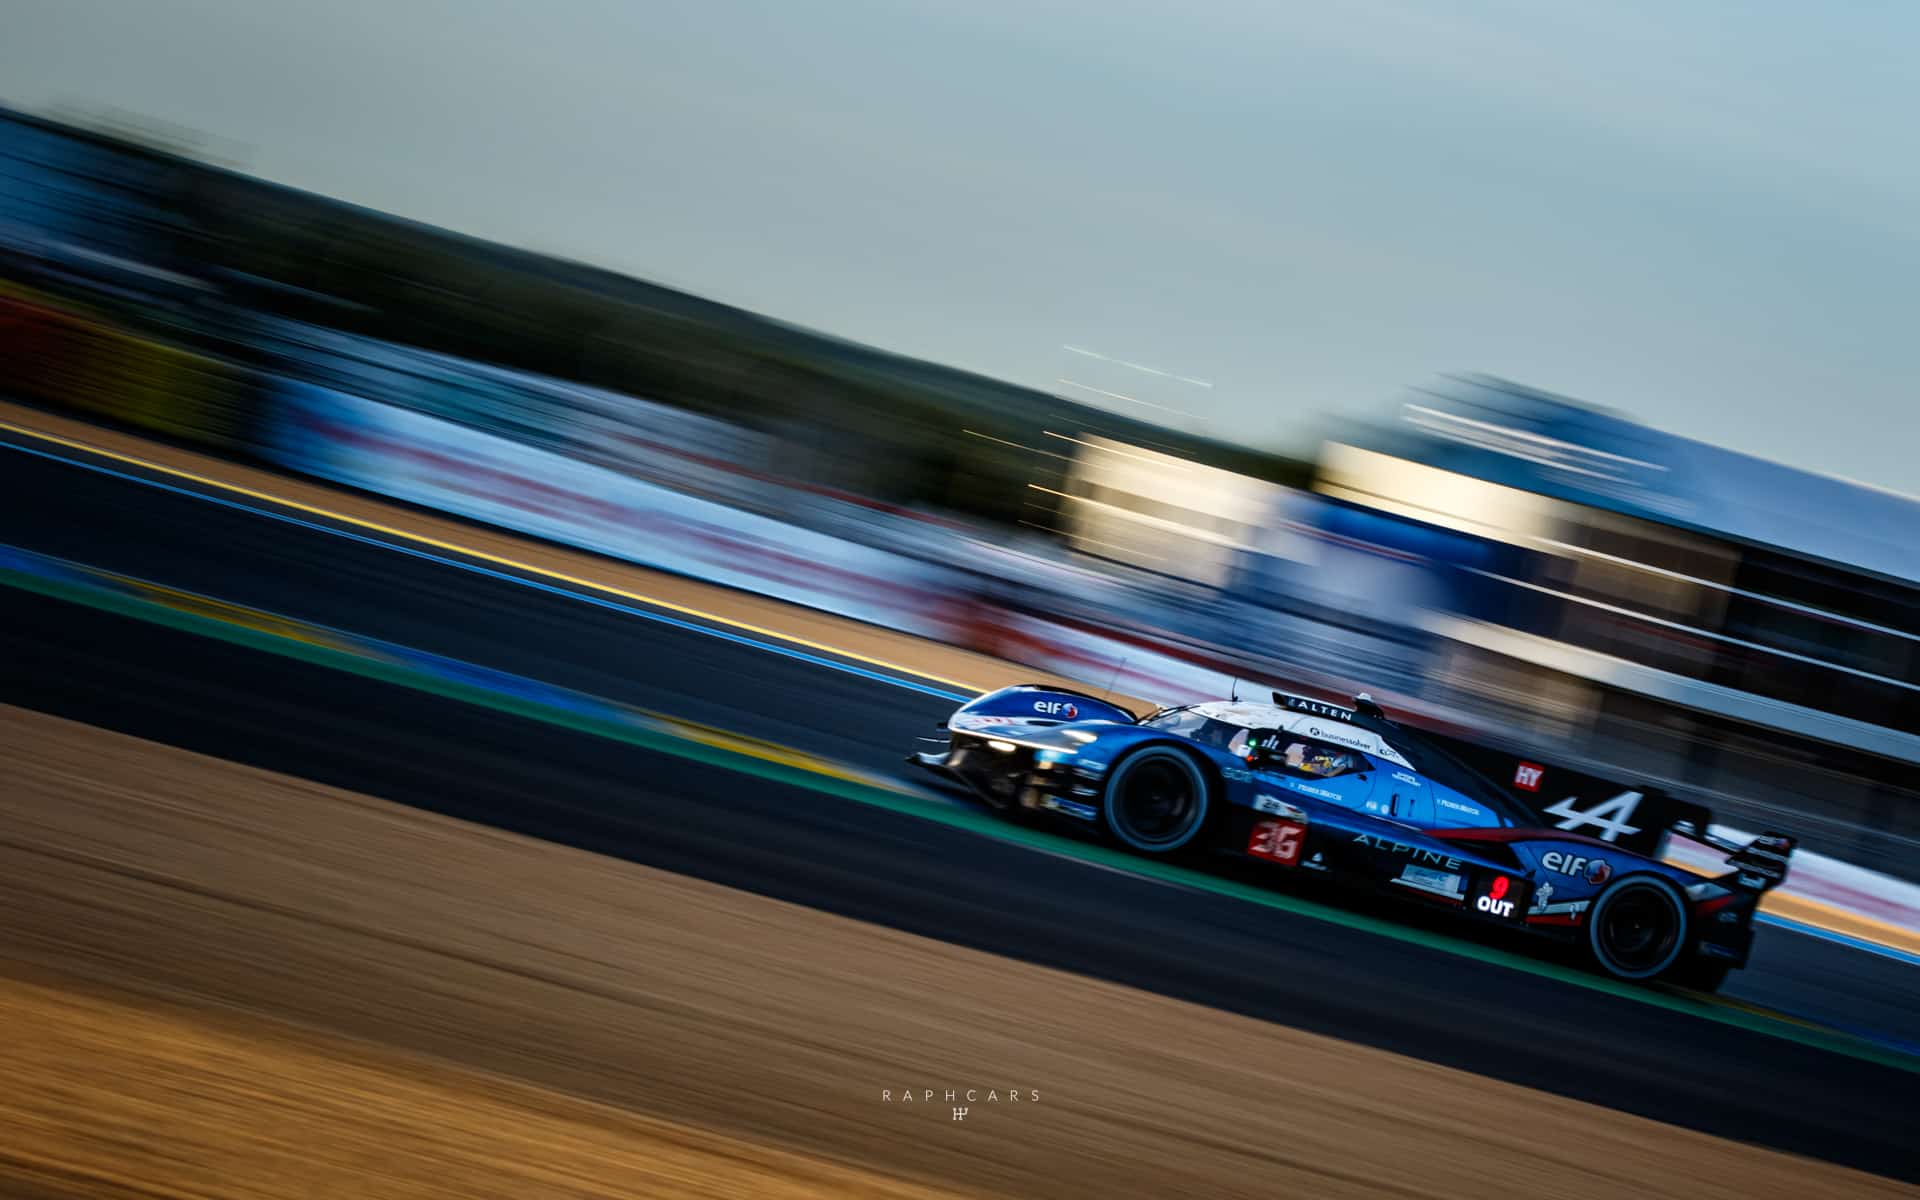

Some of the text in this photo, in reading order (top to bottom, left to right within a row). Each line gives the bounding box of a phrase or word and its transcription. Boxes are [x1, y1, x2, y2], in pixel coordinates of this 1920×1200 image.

[1033, 700, 1062, 714] elf
[1297, 701, 1352, 720] ALTEN
[1514, 765, 1544, 787] HY
[1250, 821, 1304, 860] 36
[1353, 833, 1463, 870] ALPINE
[1542, 851, 1587, 876] elf
[1488, 875, 1511, 900] 9
[1477, 896, 1514, 917] OUT
